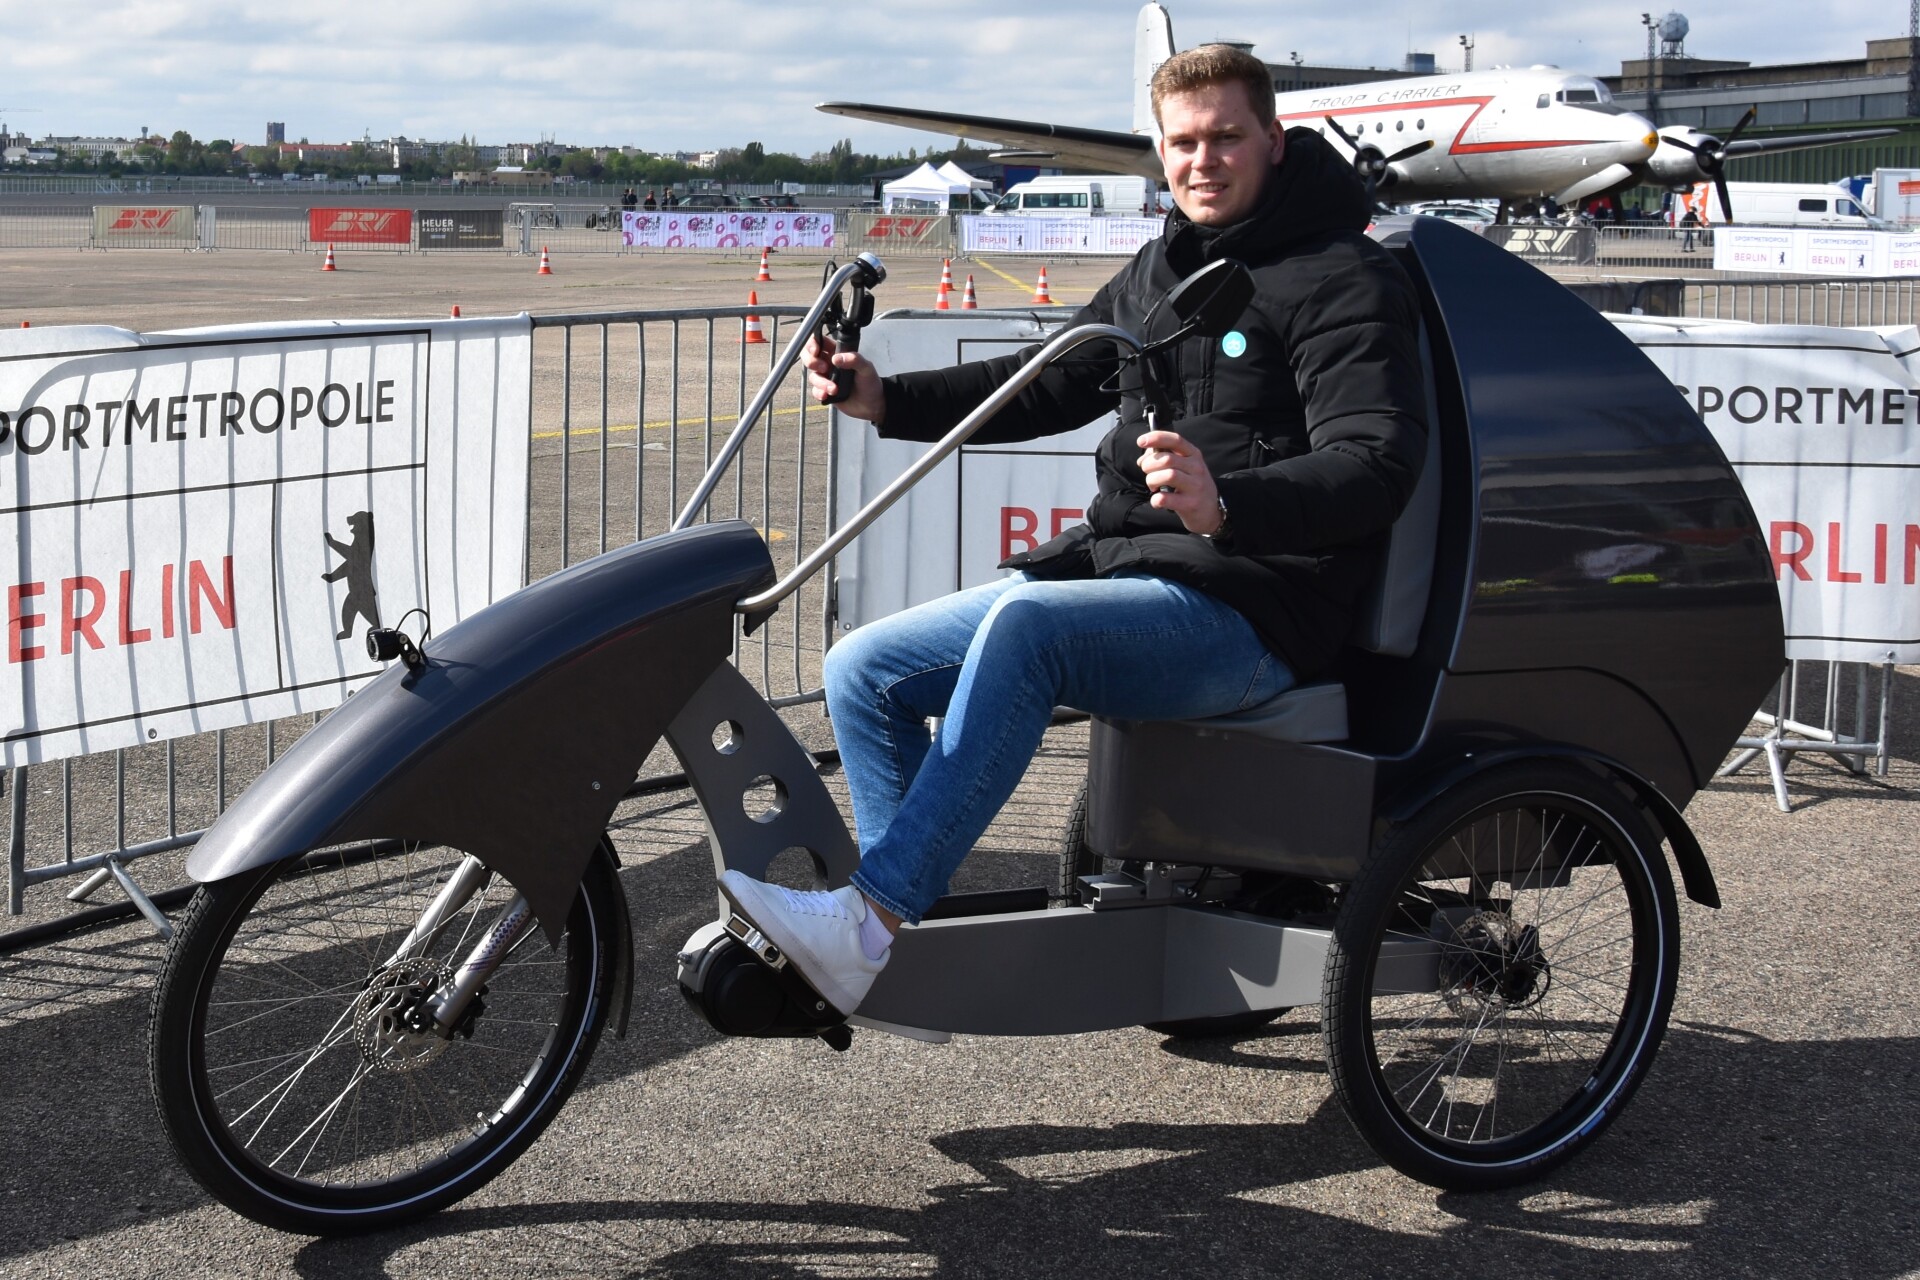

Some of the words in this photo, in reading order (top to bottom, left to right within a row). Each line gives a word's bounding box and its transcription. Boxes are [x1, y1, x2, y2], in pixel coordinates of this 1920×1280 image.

[1310, 94, 1367, 109] TROOP
[1377, 85, 1461, 103] CARRIER
[422, 219, 454, 228] HEUER
[979, 236, 1007, 244] BERLIN
[1045, 237, 1072, 245] BERLIN
[1109, 238, 1138, 246] BERLIN
[1734, 252, 1767, 262] BERLIN
[1811, 255, 1846, 265] BERLIN
